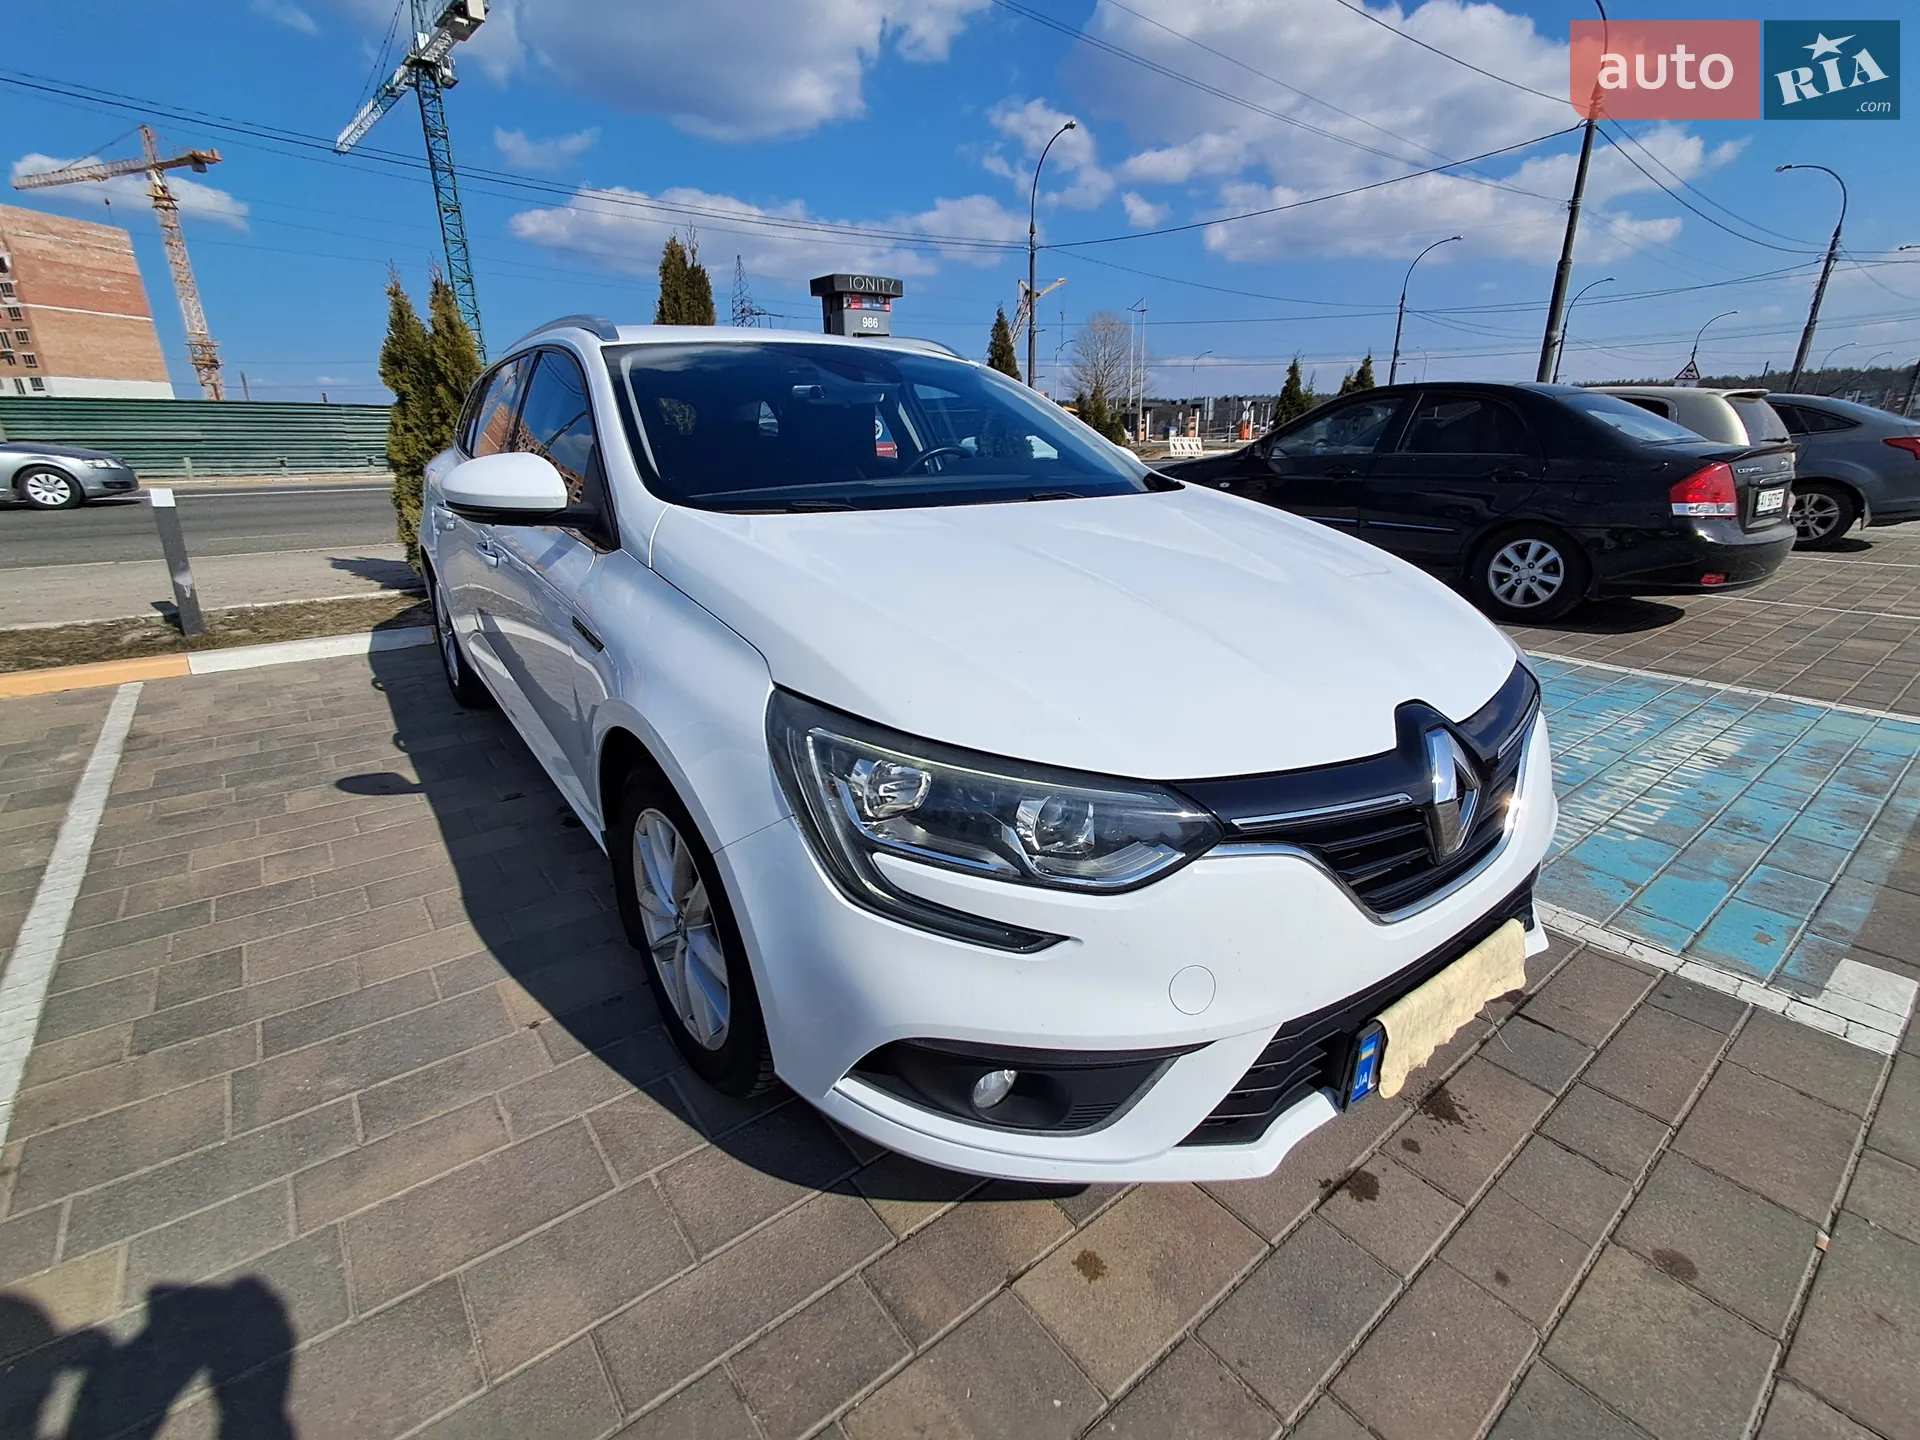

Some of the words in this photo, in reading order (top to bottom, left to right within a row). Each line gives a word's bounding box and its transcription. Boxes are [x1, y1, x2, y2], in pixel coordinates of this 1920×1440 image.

[849, 276, 895, 292] IONITY
[862, 317, 879, 328] 986
[1354, 1071, 1368, 1090] UA
